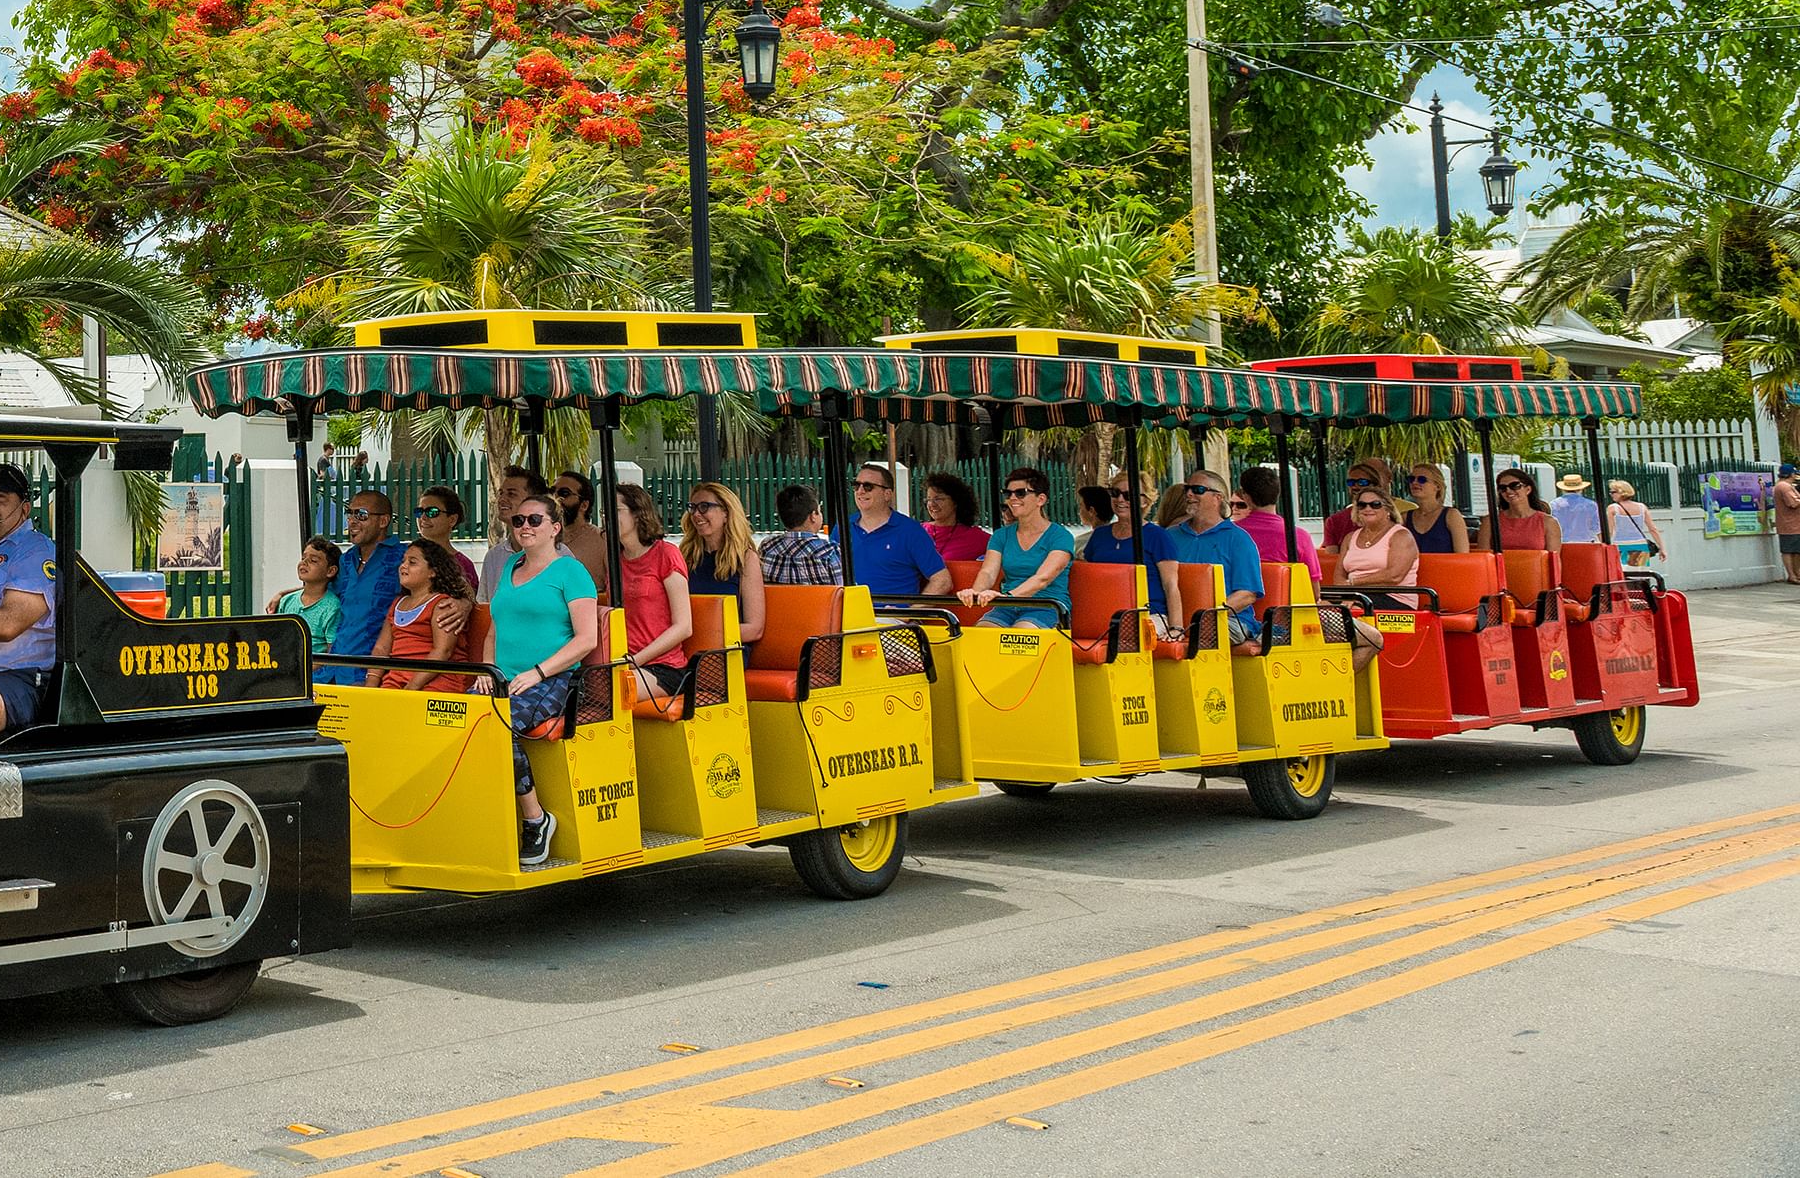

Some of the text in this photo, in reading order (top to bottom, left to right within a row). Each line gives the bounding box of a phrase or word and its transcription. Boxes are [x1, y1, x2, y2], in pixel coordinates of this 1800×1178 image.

[1378, 614, 1413, 622] CAUTION
[1001, 634, 1038, 644] CAUTION
[119, 640, 279, 677] OVERSEAS R.R.
[185, 673, 219, 700] 108
[428, 700, 466, 713] CAUTION
[1122, 695, 1146, 710] STOCK
[1283, 698, 1348, 722] OVERSEAS R.R.
[1122, 710, 1149, 726] ISLAND
[828, 742, 923, 779] OVERSEAS R.R.
[577, 780, 635, 807] BIG TORCH
[596, 802, 618, 823] KEY
